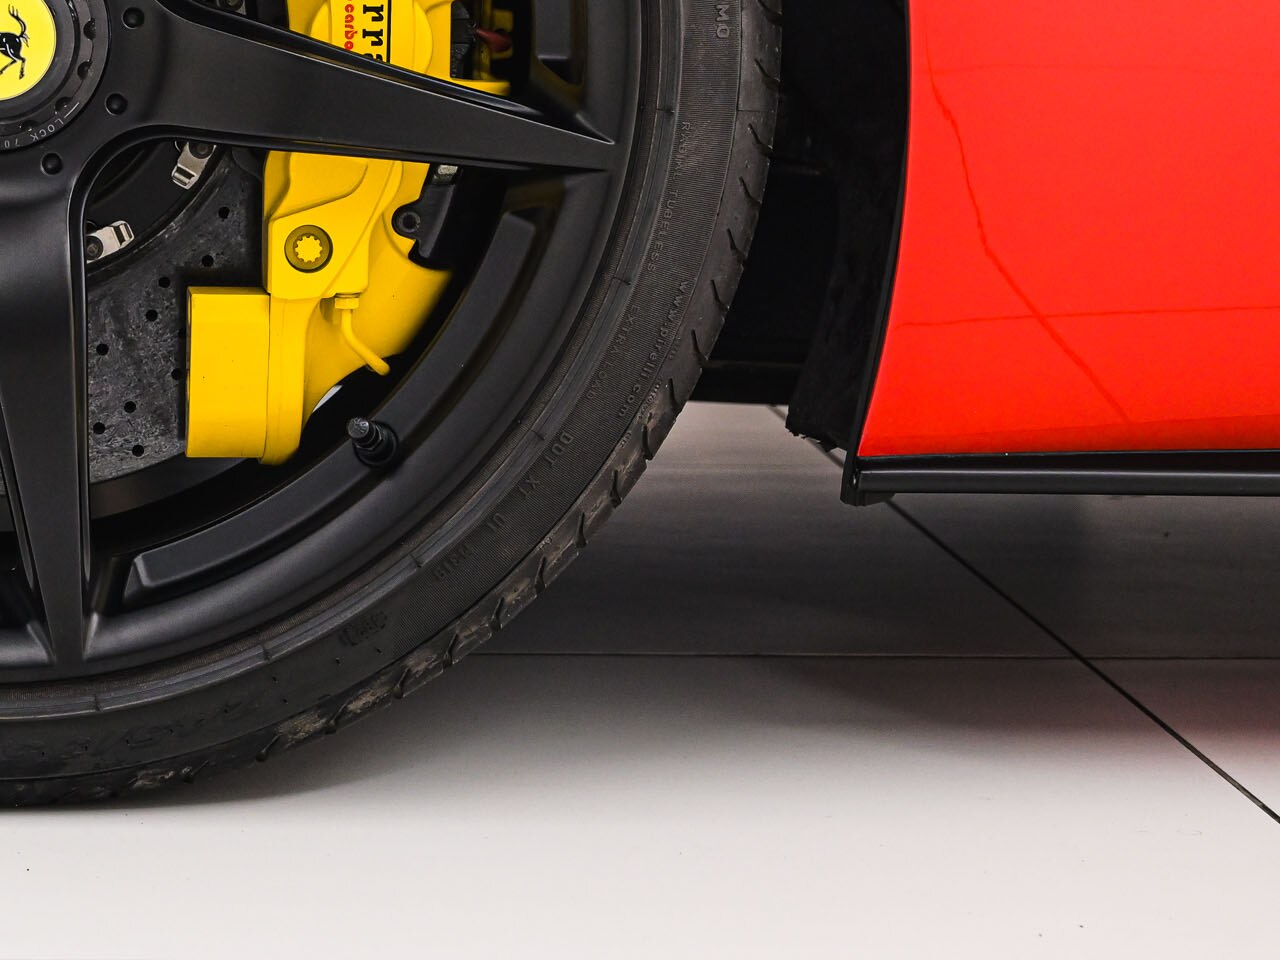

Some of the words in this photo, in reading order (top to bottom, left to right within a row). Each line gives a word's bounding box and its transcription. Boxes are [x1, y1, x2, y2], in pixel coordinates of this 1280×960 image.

[30, 118, 64, 142] LOCK
[539, 429, 574, 468] DOT
[513, 472, 539, 499] XT
